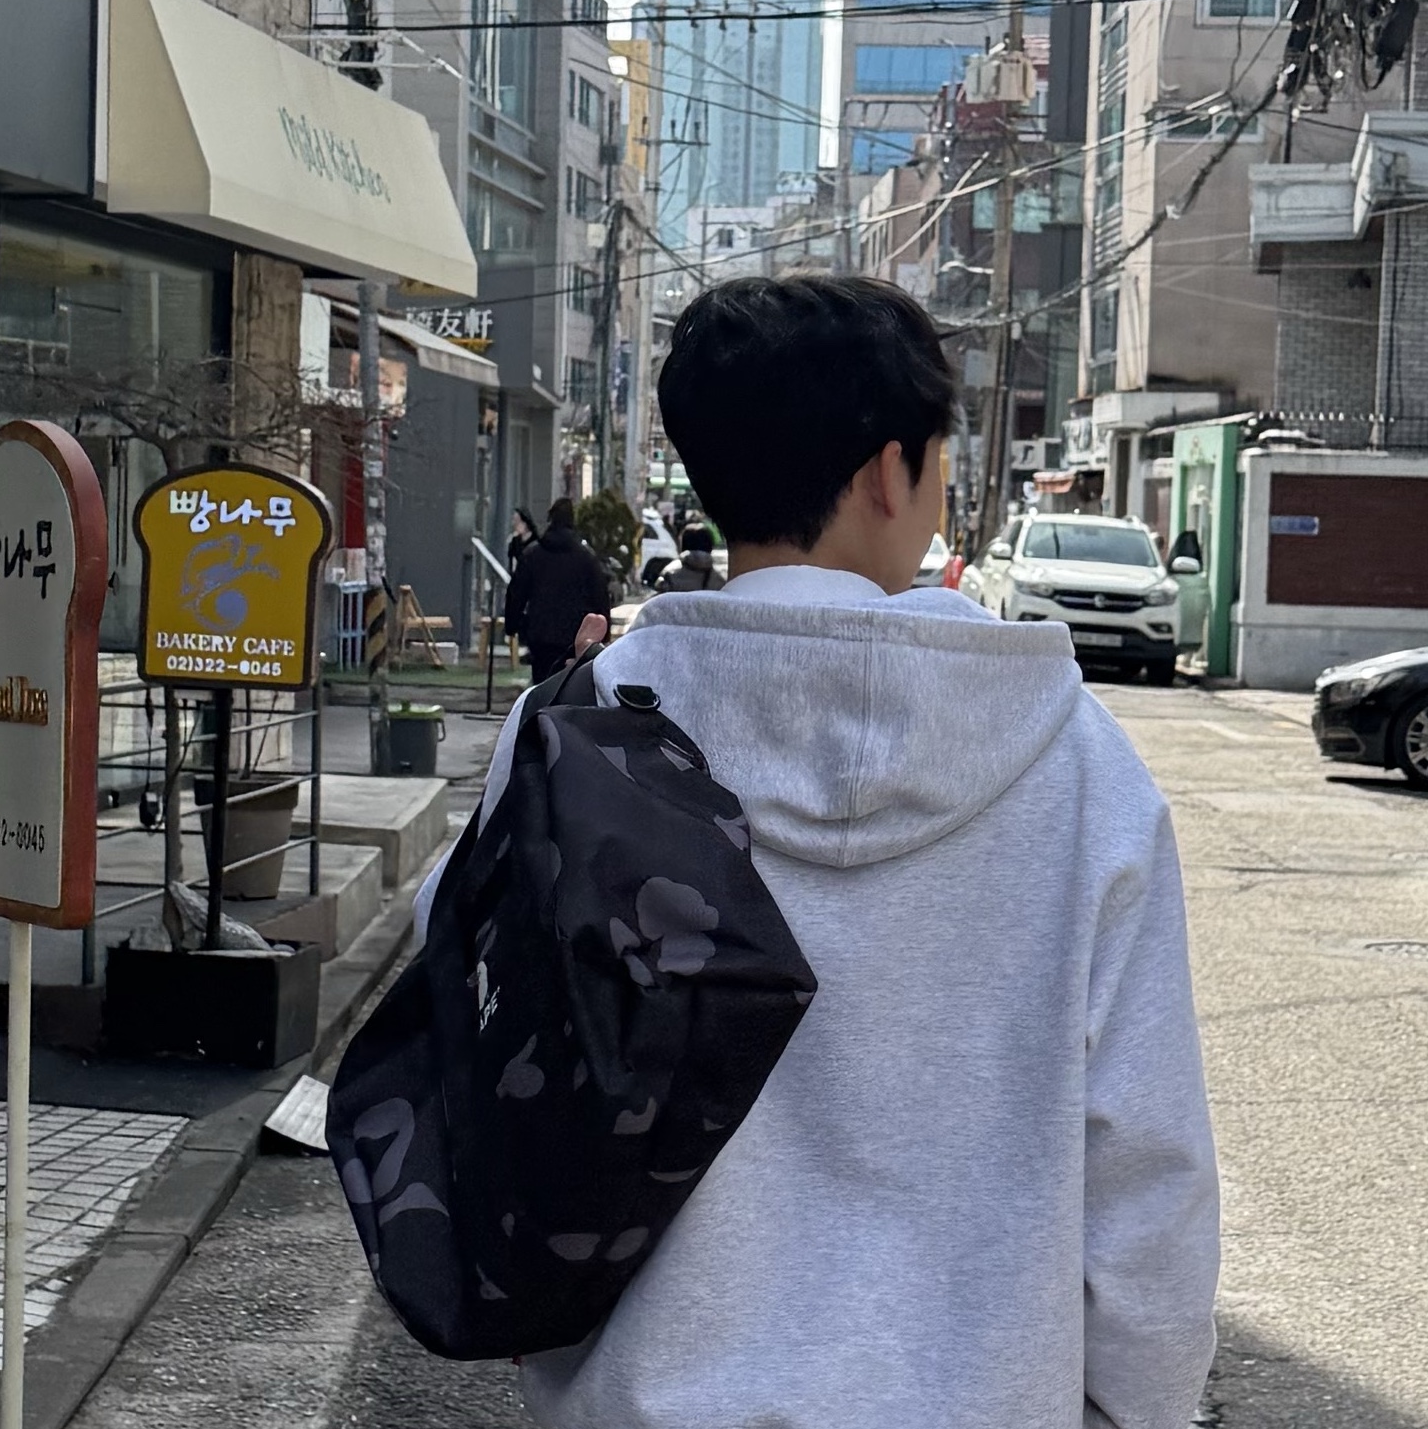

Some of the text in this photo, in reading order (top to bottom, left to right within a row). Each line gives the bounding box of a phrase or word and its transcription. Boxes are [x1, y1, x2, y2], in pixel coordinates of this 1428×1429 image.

[169, 489, 297, 537] 빵나무
[156, 631, 296, 658] BAKERY CAFE
